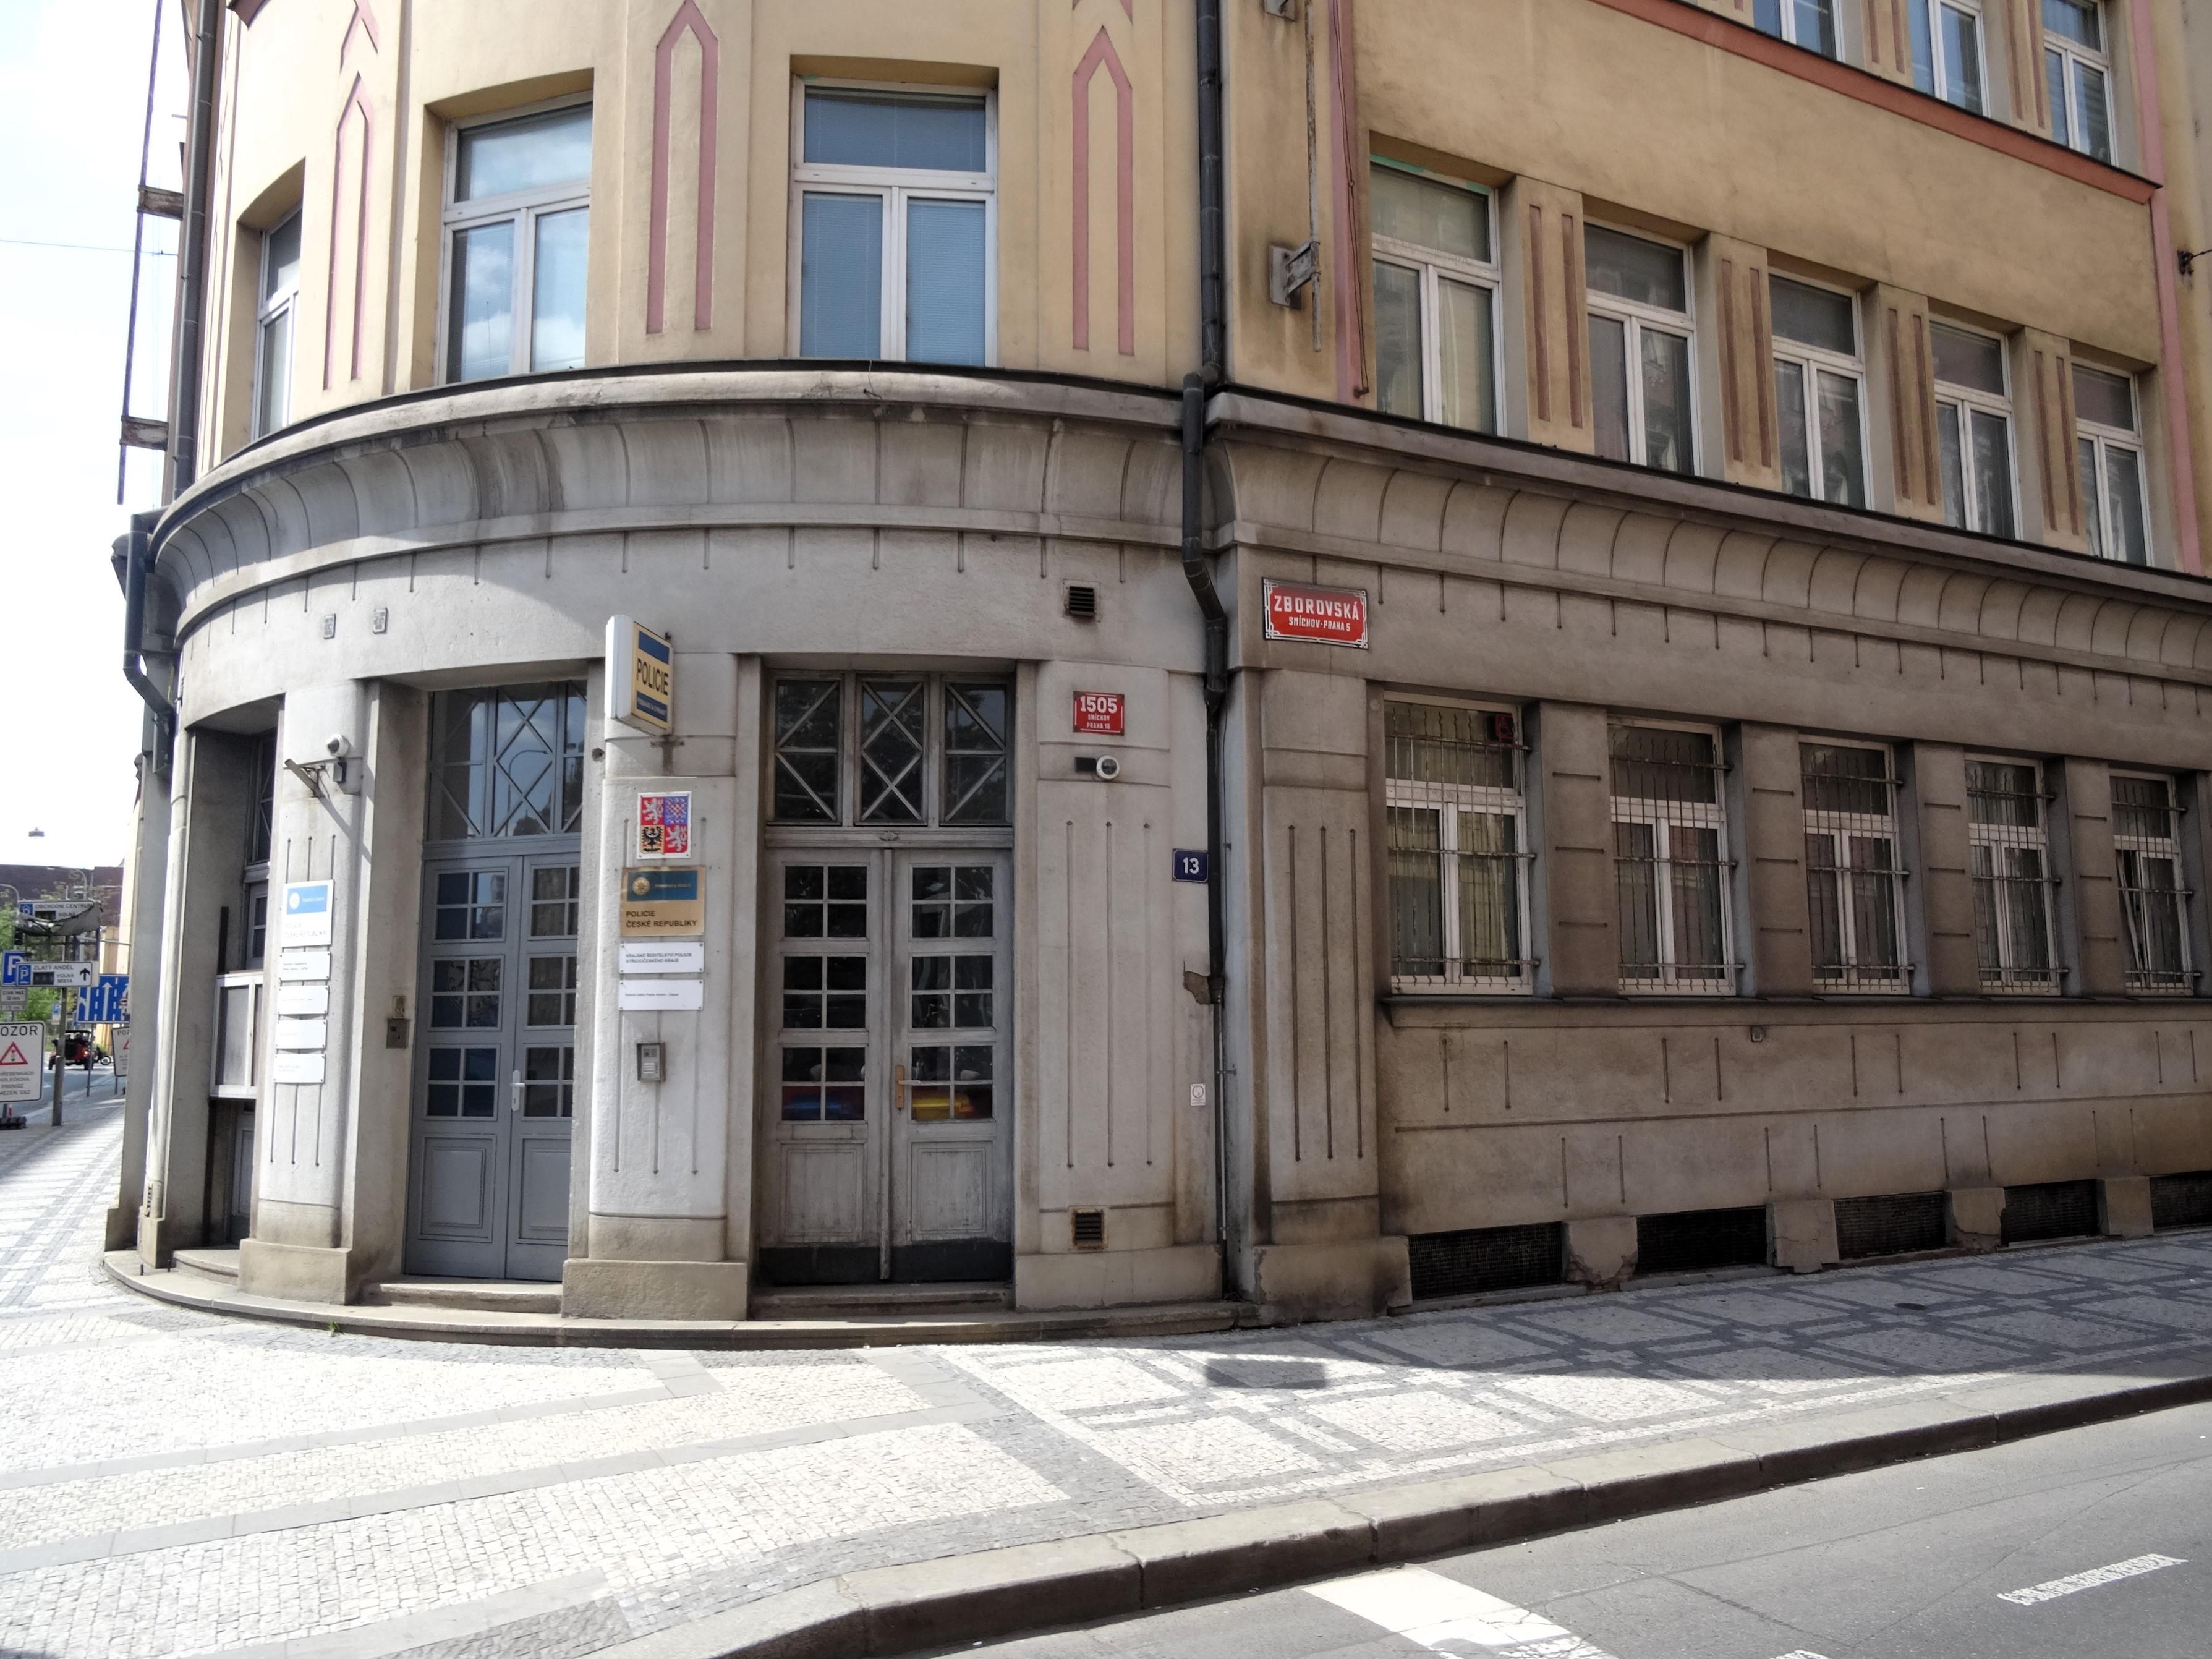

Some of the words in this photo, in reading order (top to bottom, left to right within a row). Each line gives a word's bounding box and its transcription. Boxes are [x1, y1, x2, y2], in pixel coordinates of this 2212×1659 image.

[1274, 595, 1359, 620] ZBOROVSKÁ
[1288, 615, 1320, 628] SMÍCHOV
[1323, 620, 1345, 631] PRAHA
[1346, 623, 1350, 631] 5
[637, 658, 669, 696] POLICIE
[1080, 696, 1118, 714] 1505
[1087, 713, 1110, 721] SMÍCHOV
[1183, 857, 1199, 874] 13
[625, 910, 656, 918] POLICIE
[626, 919, 652, 928] ČESKÉ
[653, 919, 697, 928] REPUBLIKY
[0, 1025, 38, 1036] OZOR
